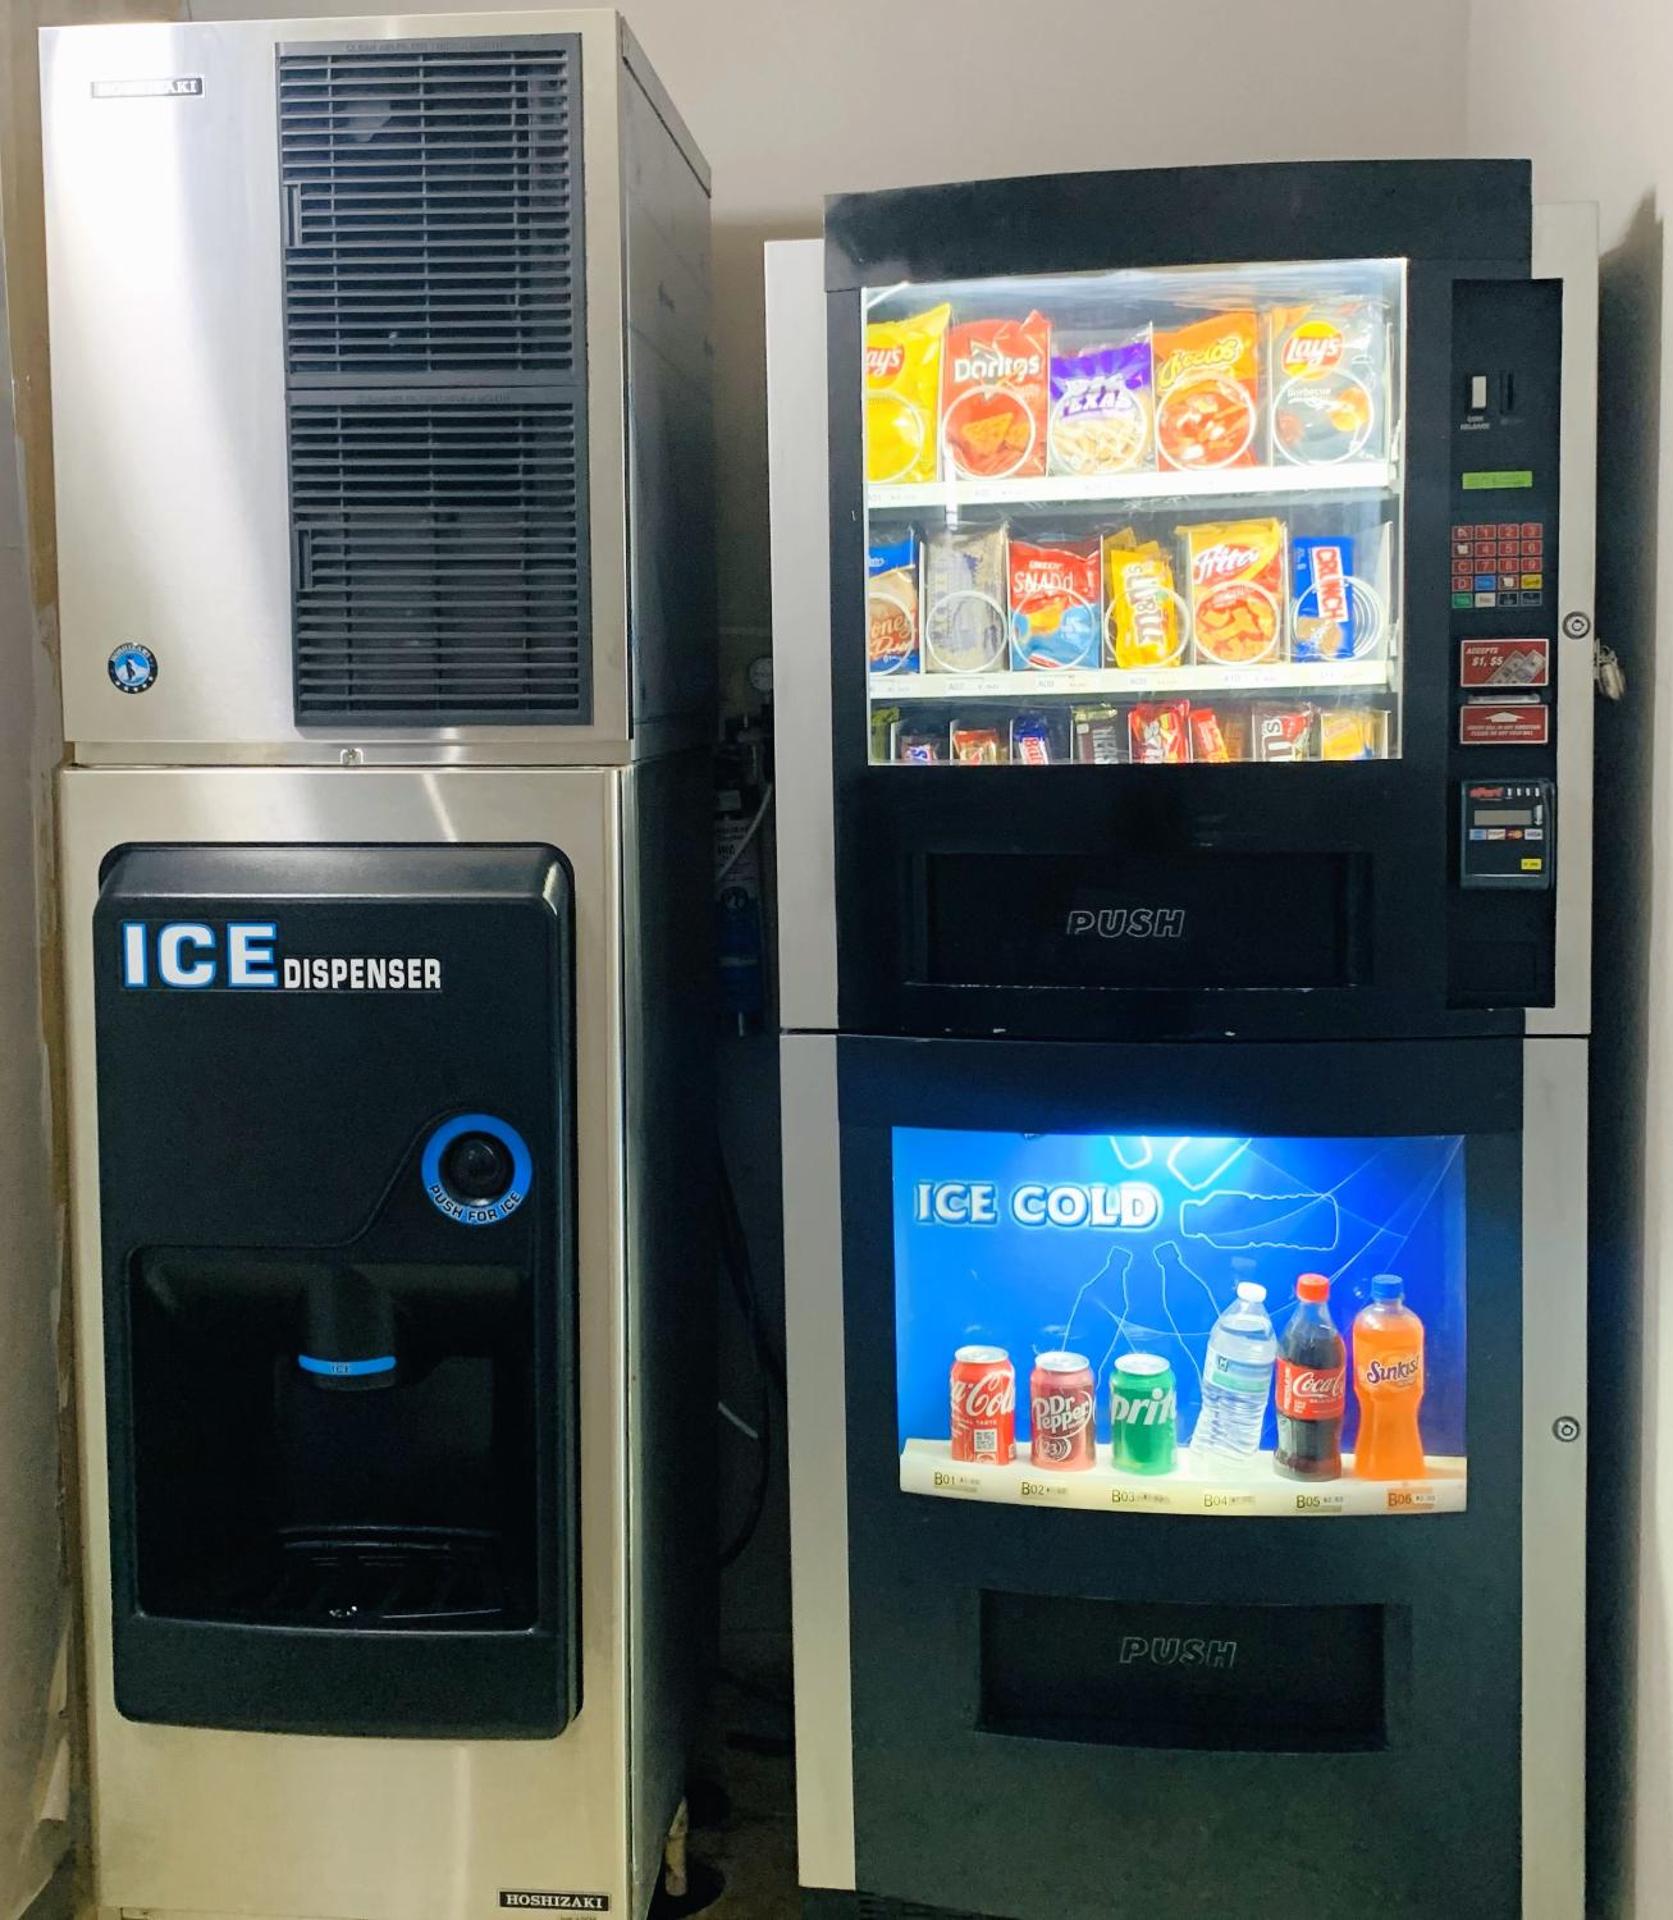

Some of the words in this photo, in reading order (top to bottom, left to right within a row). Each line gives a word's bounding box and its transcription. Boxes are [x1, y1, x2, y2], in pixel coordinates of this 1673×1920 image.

[953, 354, 1040, 383] Doritos
[1066, 908, 1185, 938] PUSH
[122, 920, 279, 989] ICE
[284, 958, 442, 989] DISPENSER
[429, 1184, 463, 1218] PUSH
[468, 1209, 498, 1222] FOR
[500, 1192, 521, 1213] ICE
[916, 1181, 998, 1223] ICE
[1012, 1183, 1160, 1229] COLD
[1050, 1395, 1076, 1412] Dr
[1033, 1397, 1091, 1434] Pepper
[934, 1472, 956, 1486] B01
[1022, 1481, 1045, 1496] B02
[1111, 1490, 1135, 1503] B03
[1203, 1494, 1229, 1508] B04
[1296, 1494, 1321, 1509] B05
[1387, 1492, 1412, 1508] B06
[1119, 1635, 1238, 1669] PUSH
[505, 1893, 603, 1909] HOSHIZAKI
